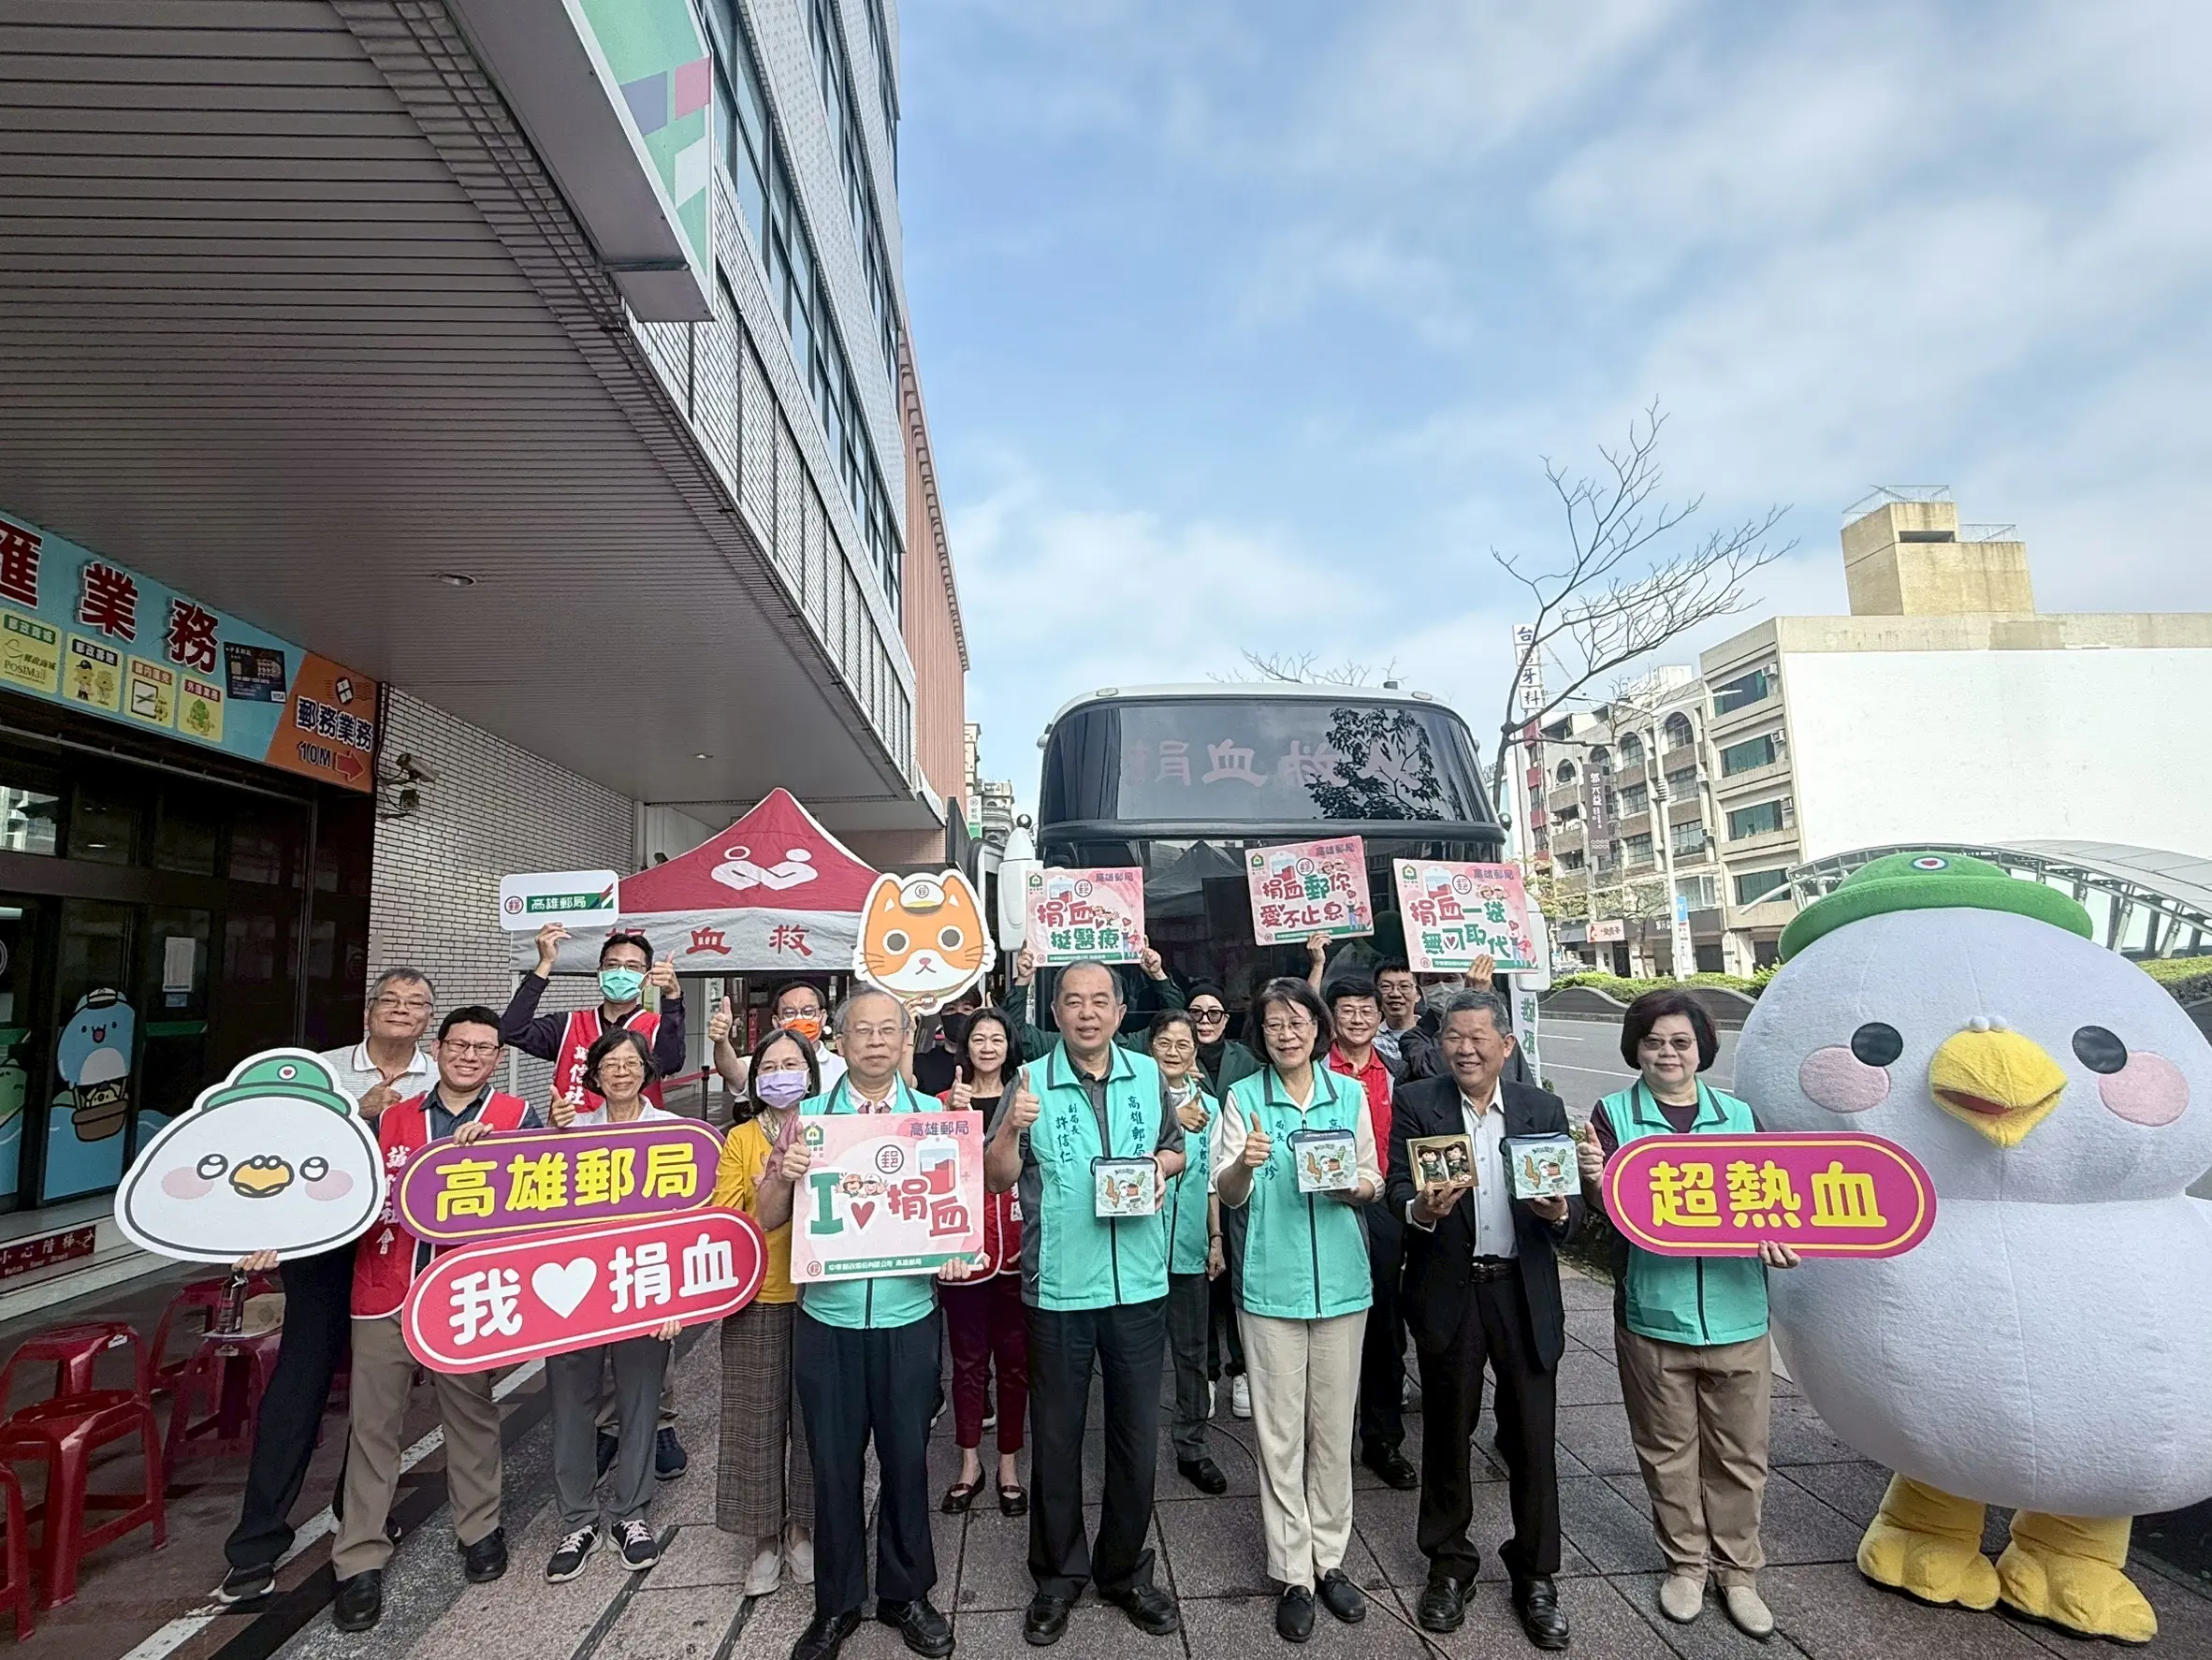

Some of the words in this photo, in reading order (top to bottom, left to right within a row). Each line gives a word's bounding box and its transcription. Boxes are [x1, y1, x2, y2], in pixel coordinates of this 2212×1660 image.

[297, 695, 373, 753] 郵務業務
[298, 740, 333, 768] 10M
[1133, 738, 1423, 791] 捐血救人
[1316, 842, 1355, 856] 高雄郵局
[1096, 872, 1134, 882] 高雄郵局
[1261, 872, 1351, 901] 捐血郵你
[1473, 868, 1515, 881] 高雄郵局
[531, 896, 587, 910] 高雄郵局
[1037, 900, 1094, 927] 捐血
[1259, 901, 1345, 929] 愛不止息
[1409, 896, 1507, 927] 捐血一袋
[1050, 927, 1120, 951] 挺醫療
[1420, 923, 1512, 959] 無可取代
[910, 1120, 969, 1136] 高雄郵局
[1068, 1103, 1081, 1135] 副局長
[1128, 1095, 1146, 1157] 高雄郵局
[1055, 1115, 1074, 1164] 許信仁
[435, 1143, 698, 1222] 高雄郵局
[1649, 1159, 1888, 1230] 超熱血
[810, 1172, 843, 1235] I
[888, 1178, 971, 1238] 捐血
[449, 1268, 523, 1346] 我
[608, 1233, 739, 1314] 捐血
